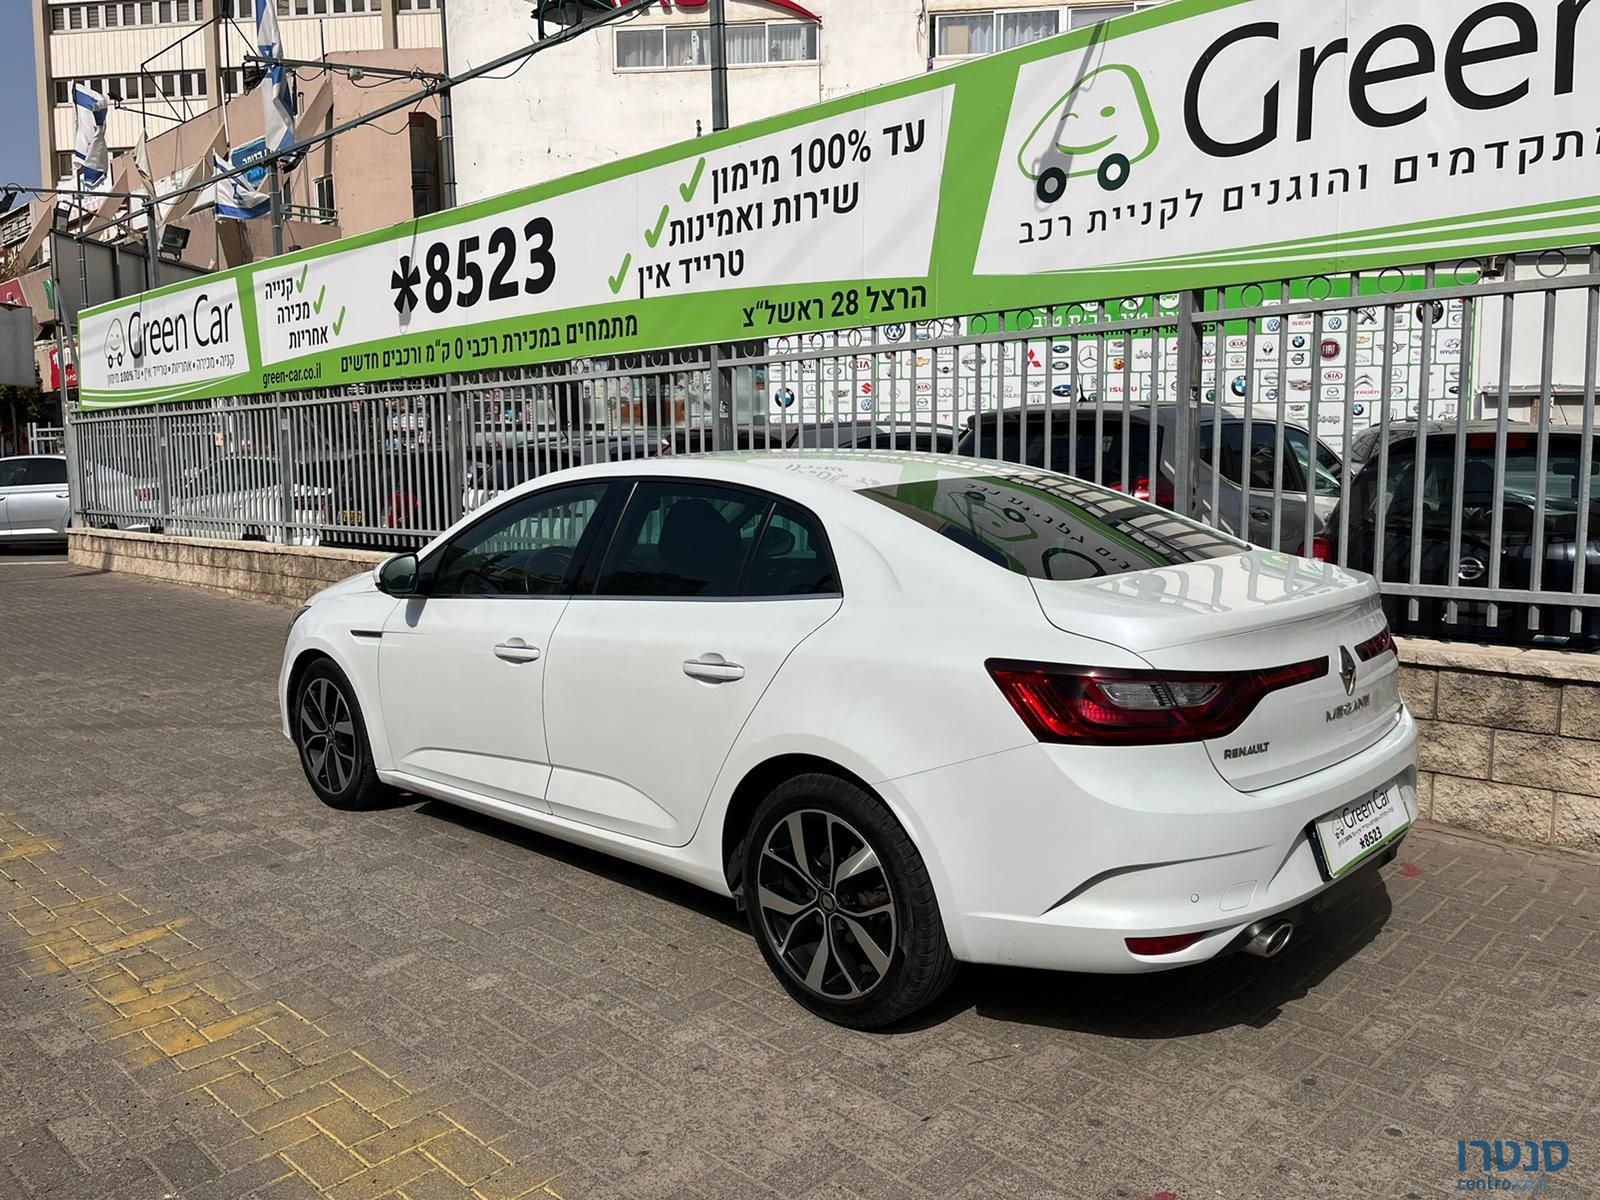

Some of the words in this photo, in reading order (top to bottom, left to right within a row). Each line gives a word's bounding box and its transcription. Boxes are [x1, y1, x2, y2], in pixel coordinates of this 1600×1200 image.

[883, 119, 925, 157] עד
[791, 129, 872, 178] 100%
[1393, 127, 1600, 184] תקדמים
[712, 154, 779, 203] מימון
[1222, 163, 1368, 212] והוגנים
[771, 181, 859, 227] שירות
[1086, 189, 1203, 234] לקניית
[669, 202, 763, 247] ואמינות
[1018, 215, 1071, 244] רכב
[638, 261, 671, 299] אין
[679, 249, 744, 284] טרייד
[265, 277, 293, 301] קנייה
[831, 289, 859, 317] 28
[866, 285, 927, 313] הרצל
[128, 311, 188, 360] Green
[193, 294, 233, 347] Car
[277, 302, 310, 324] מכירה
[289, 325, 328, 349] אחריות
[501, 327, 561, 354] במכירת
[566, 314, 638, 345] מתמחים
[382, 345, 422, 367] ורכבים
[455, 337, 463, 359] 0
[467, 335, 498, 358] רכבי
[1322, 345, 1335, 354] FIAT
[262, 362, 321, 388] green-car.co.il
[341, 352, 379, 373] חדשים
[1224, 742, 1270, 760] RENAULT
[1343, 801, 1375, 828] Green
[1372, 789, 1390, 809] Car
